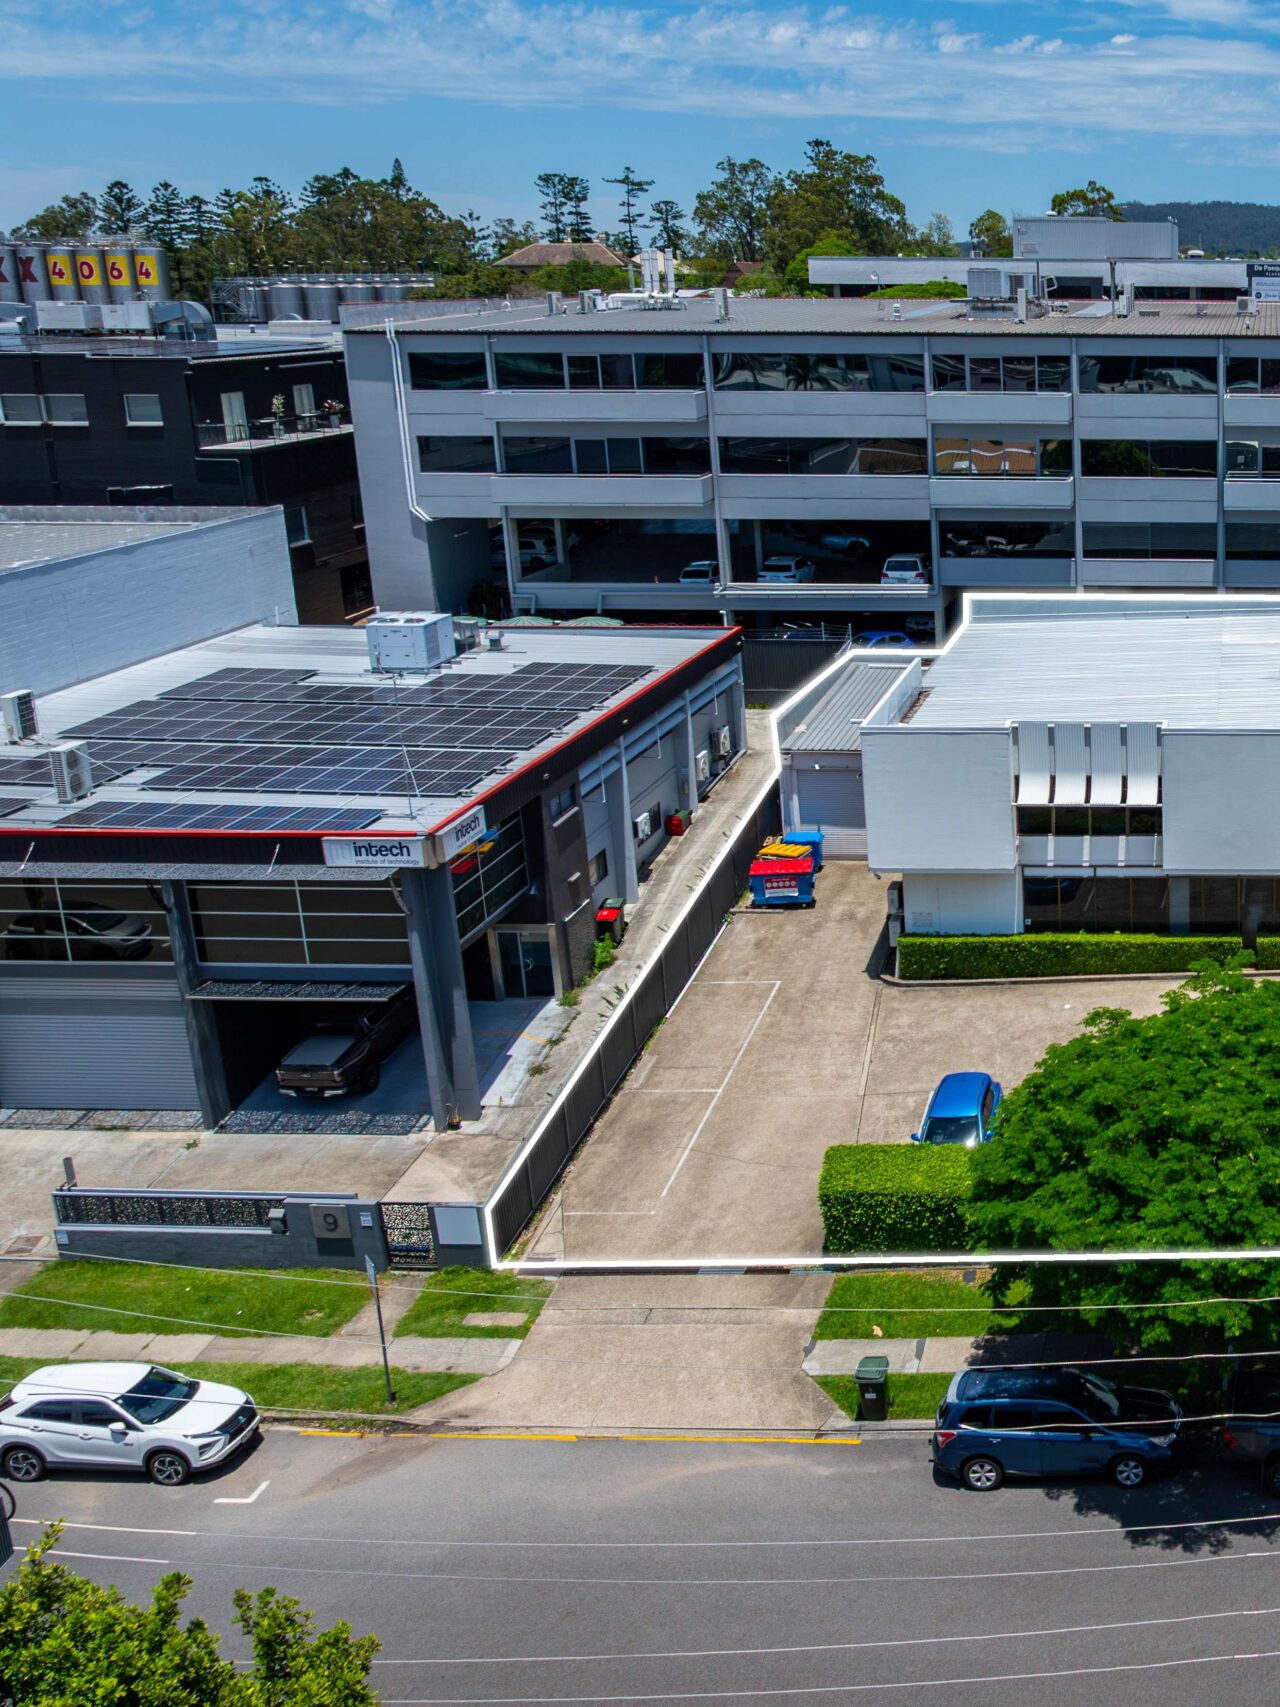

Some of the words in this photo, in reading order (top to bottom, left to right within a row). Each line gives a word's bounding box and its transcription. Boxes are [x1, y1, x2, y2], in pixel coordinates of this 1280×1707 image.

[51, 260, 153, 281] 4064
[352, 841, 411, 857] intech
[386, 858, 419, 866] technology
[323, 1213, 339, 1232] 9
